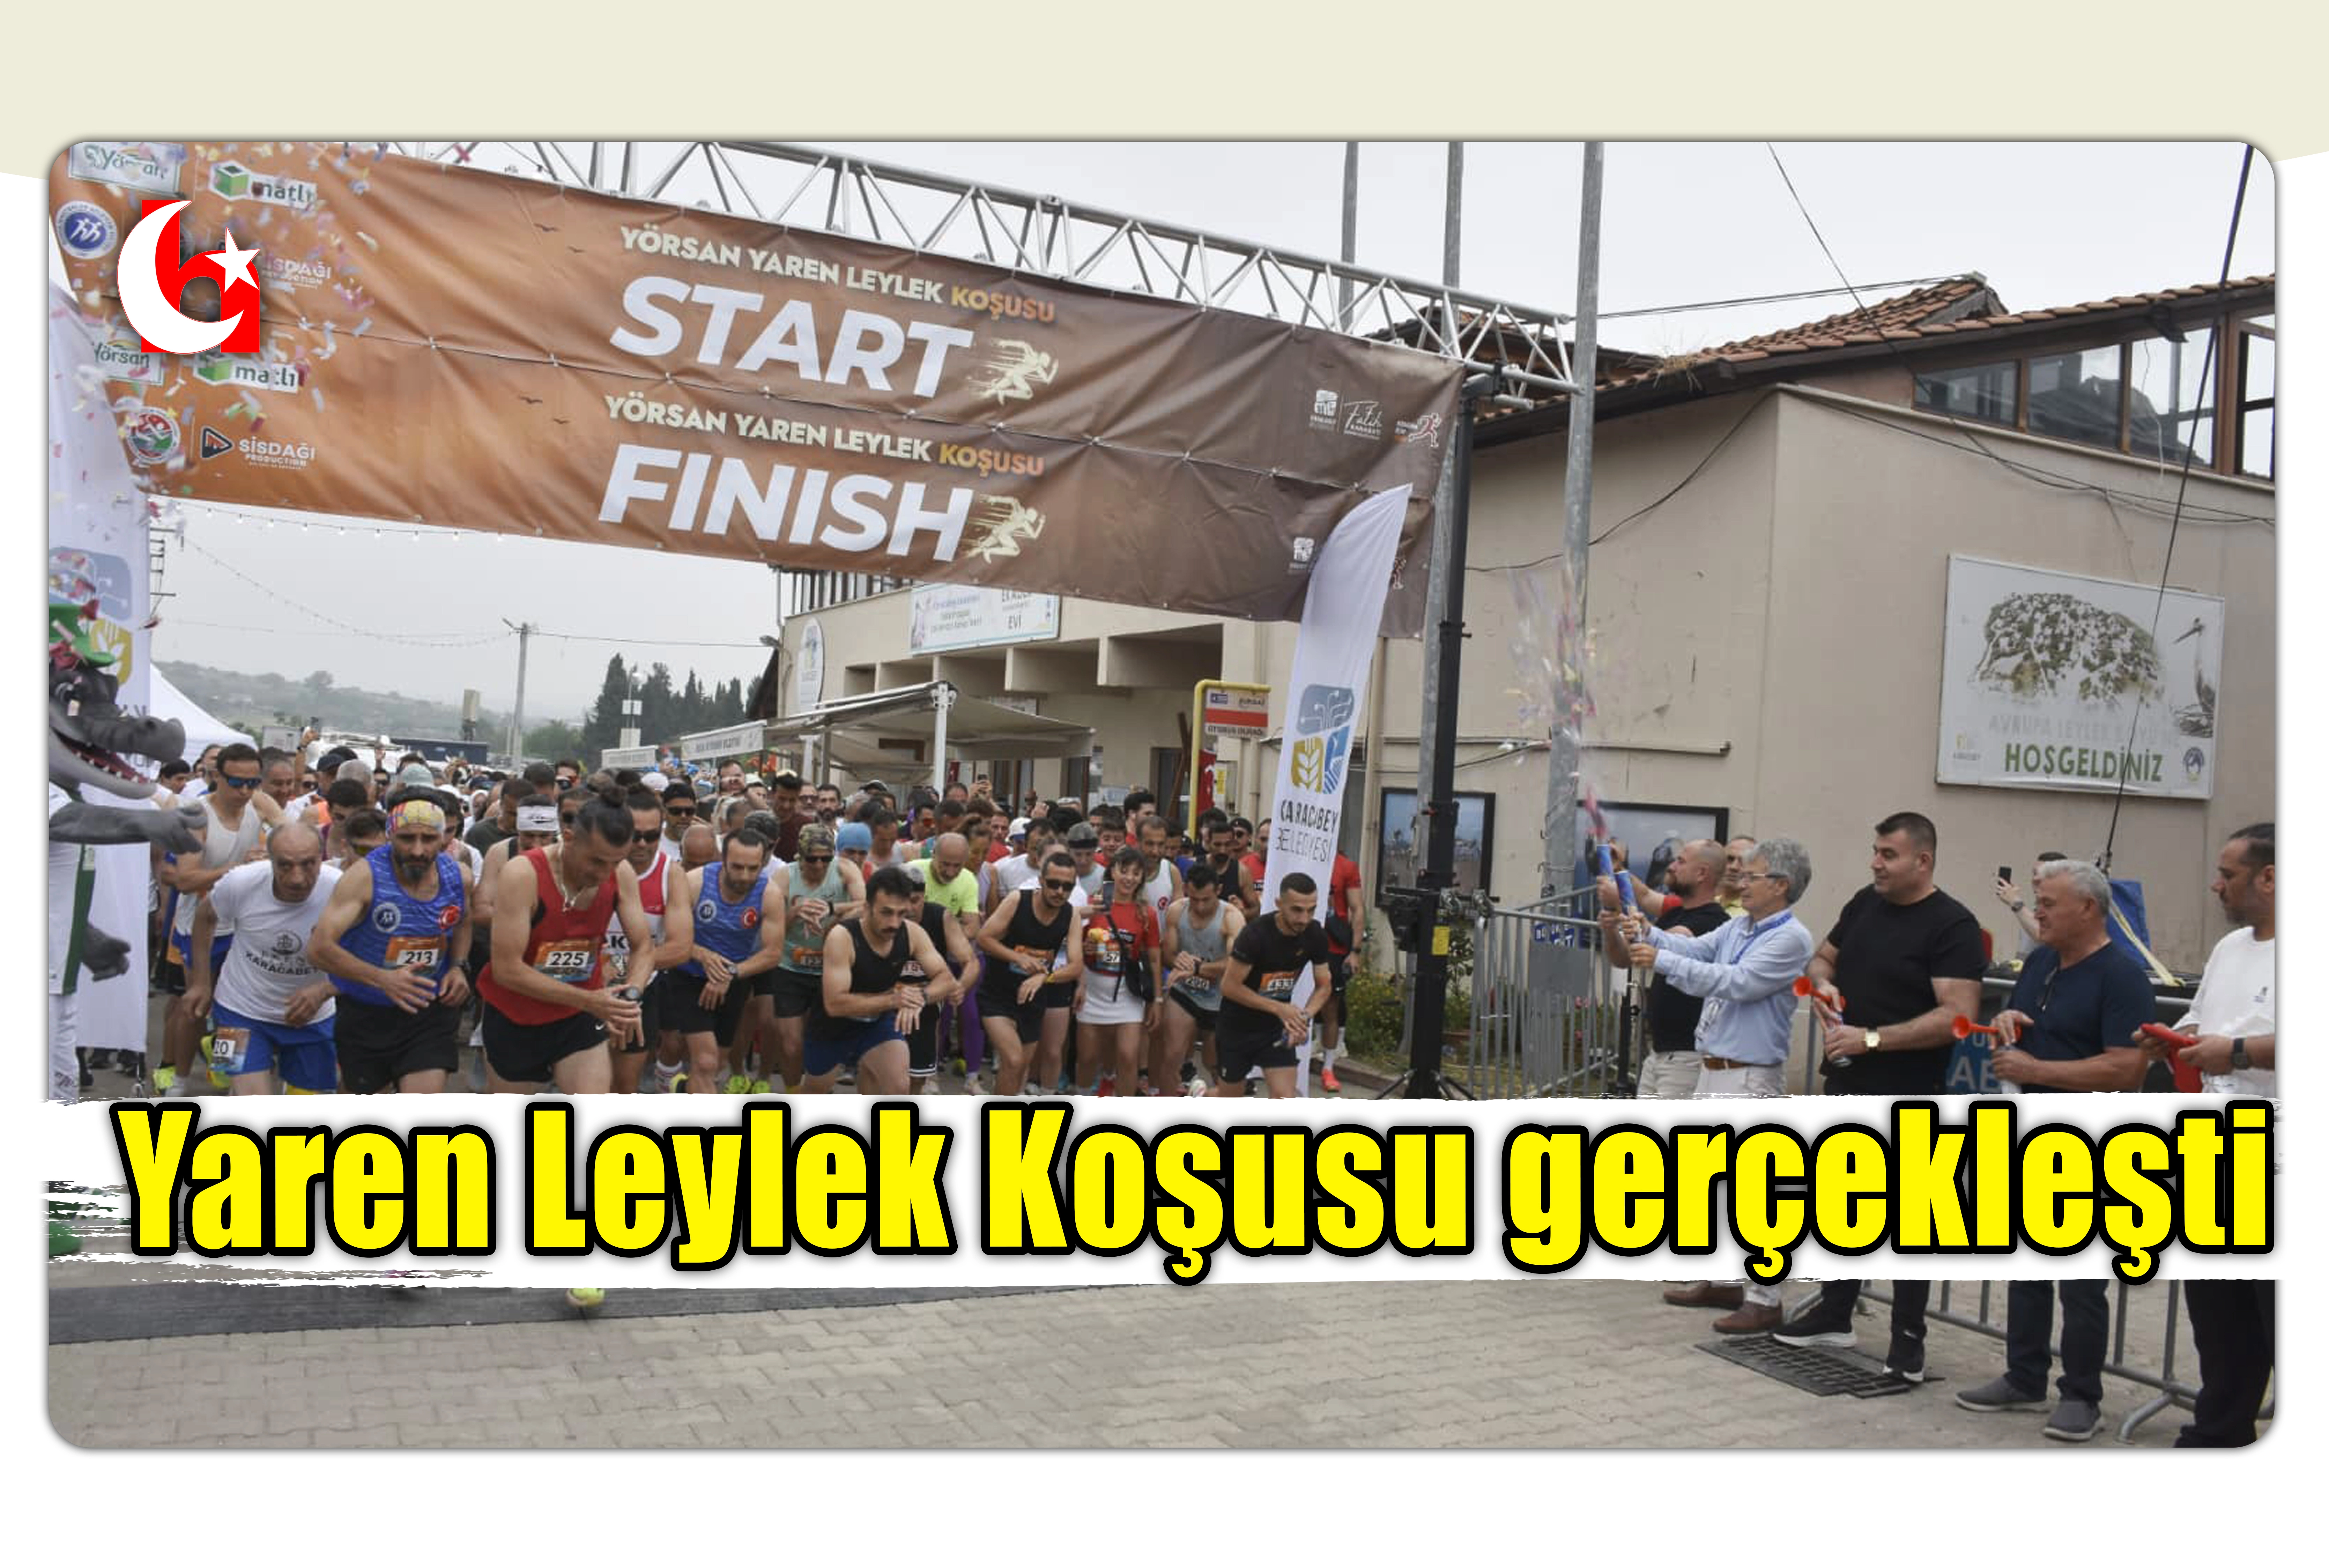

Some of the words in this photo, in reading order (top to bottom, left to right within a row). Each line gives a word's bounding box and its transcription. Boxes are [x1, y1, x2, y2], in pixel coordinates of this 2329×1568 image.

[621, 224, 740, 267] YÖRSAN
[748, 249, 838, 284] YAREN
[847, 267, 943, 304] LEYLEK
[950, 286, 1055, 323] KOŞUSU
[94, 341, 149, 369] Yörsan
[609, 276, 974, 398] START
[239, 436, 315, 460] SİSDAĞI
[604, 391, 726, 434] YÖRSAN
[734, 413, 827, 447] YAREN
[835, 428, 931, 462] LEYLEK
[939, 443, 1044, 477] KOŞUSU
[599, 444, 973, 562] FINISH
[2004, 742, 2163, 782] HOŞGELDİNİZ
[404, 951, 432, 964] 213
[550, 953, 584, 966] 225
